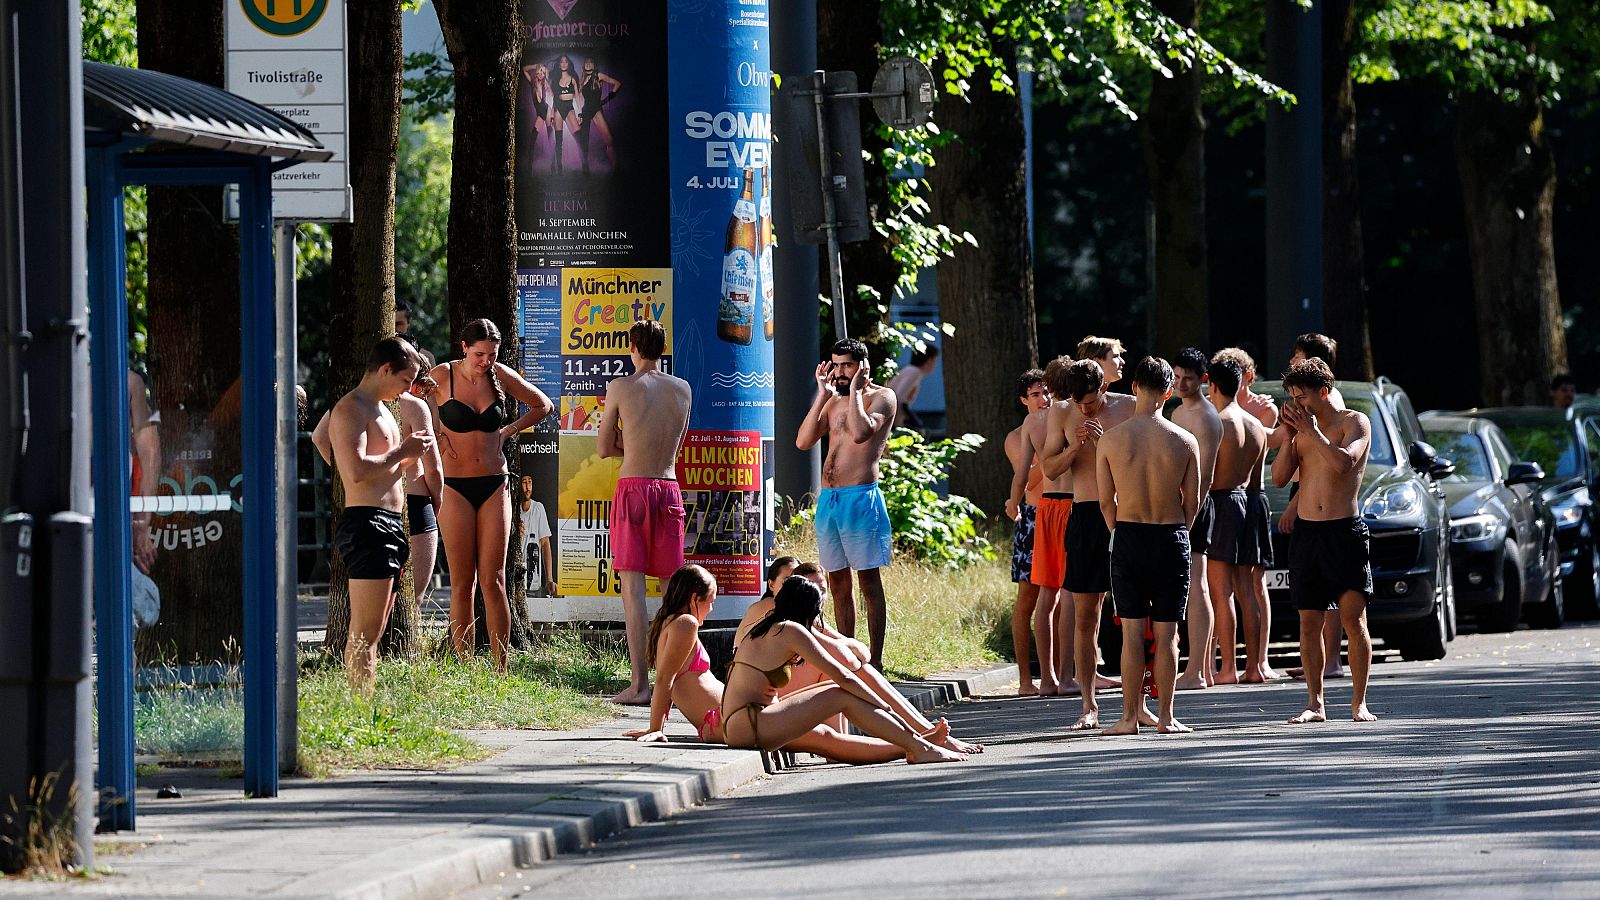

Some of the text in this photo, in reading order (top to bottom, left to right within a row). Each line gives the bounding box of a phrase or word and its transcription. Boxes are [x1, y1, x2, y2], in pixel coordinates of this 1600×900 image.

[248, 71, 323, 83] Tivolistraße
[685, 111, 771, 139] SOMM
[706, 141, 771, 168] EVEN
[273, 172, 320, 180] satzverkehr
[686, 175, 739, 189] 4. JULI
[563, 200, 588, 212] KIM
[539, 218, 597, 227] 14. SEPTEMBER
[577, 230, 627, 240] MÜNCHEN
[530, 274, 545, 286] OPEN
[547, 274, 558, 286] AIR
[568, 275, 662, 295] Münchner
[574, 296, 666, 325] Creativ
[568, 327, 630, 350] Somm
[564, 380, 595, 390] Zenith
[685, 467, 753, 486] WOCHEN
[576, 499, 612, 529] TUTU
